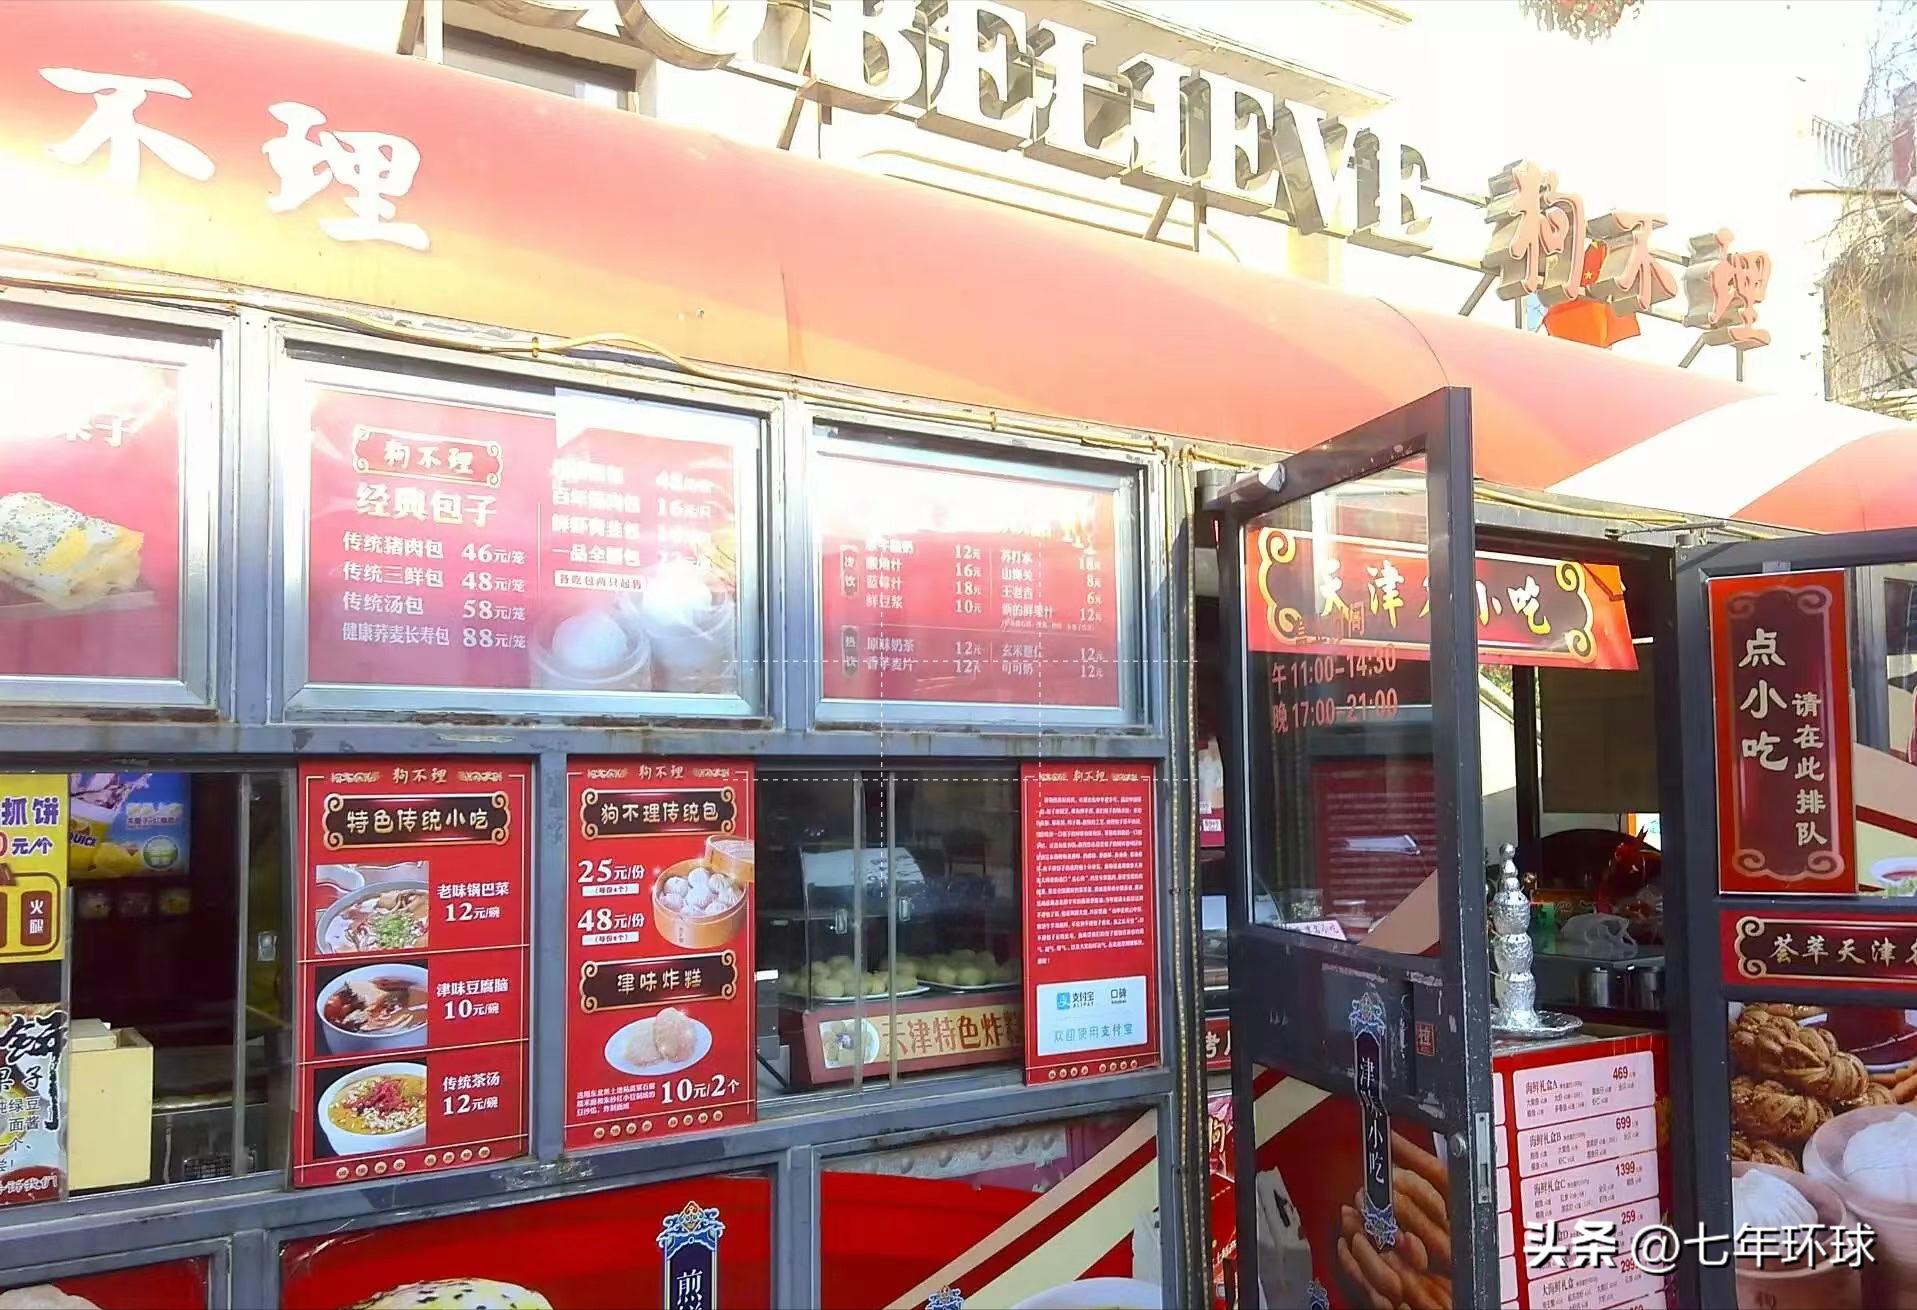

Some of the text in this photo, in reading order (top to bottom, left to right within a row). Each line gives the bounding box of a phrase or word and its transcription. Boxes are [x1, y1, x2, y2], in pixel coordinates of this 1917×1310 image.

[808, 0, 1434, 250] BELIEVE
[38, 66, 431, 250] 不理
[1505, 160, 1772, 350] 狗不理
[383, 438, 474, 475] 狗不理
[355, 482, 497, 528] 经典包子
[342, 531, 527, 565] 传统猪肉包 46元/笼
[342, 560, 527, 593] 传统三鲜包 48元/笼
[342, 591, 527, 621] 传统汤包 58元/笼
[1318, 557, 1551, 636] 天津小吃
[342, 622, 527, 649] 健康荞麦长寿包 88元/笼
[1738, 628, 1789, 772] 点小吃
[391, 767, 448, 785] 狗不理
[638, 764, 685, 781] 狗不理
[1792, 692, 1828, 847] 请在此排队
[346, 806, 490, 834] 特色传统小吃
[600, 801, 720, 825] 狗不理传统包
[577, 858, 646, 883] 25元/份
[437, 881, 510, 900] 老味锅巴菜
[445, 902, 501, 922] 12元/碗
[577, 908, 646, 932] 48元/份
[436, 977, 509, 998] 津味豆腐脑
[617, 968, 702, 995] 津味炸糕
[444, 999, 500, 1020] 10元/碗
[1072, 991, 1094, 1003] 支付宝
[1054, 1023, 1133, 1043] 欢迎使用支付宝
[442, 1071, 501, 1092] 传统茶汤
[661, 1074, 740, 1104] 10元/2个
[443, 1094, 499, 1116] 12元/碗
